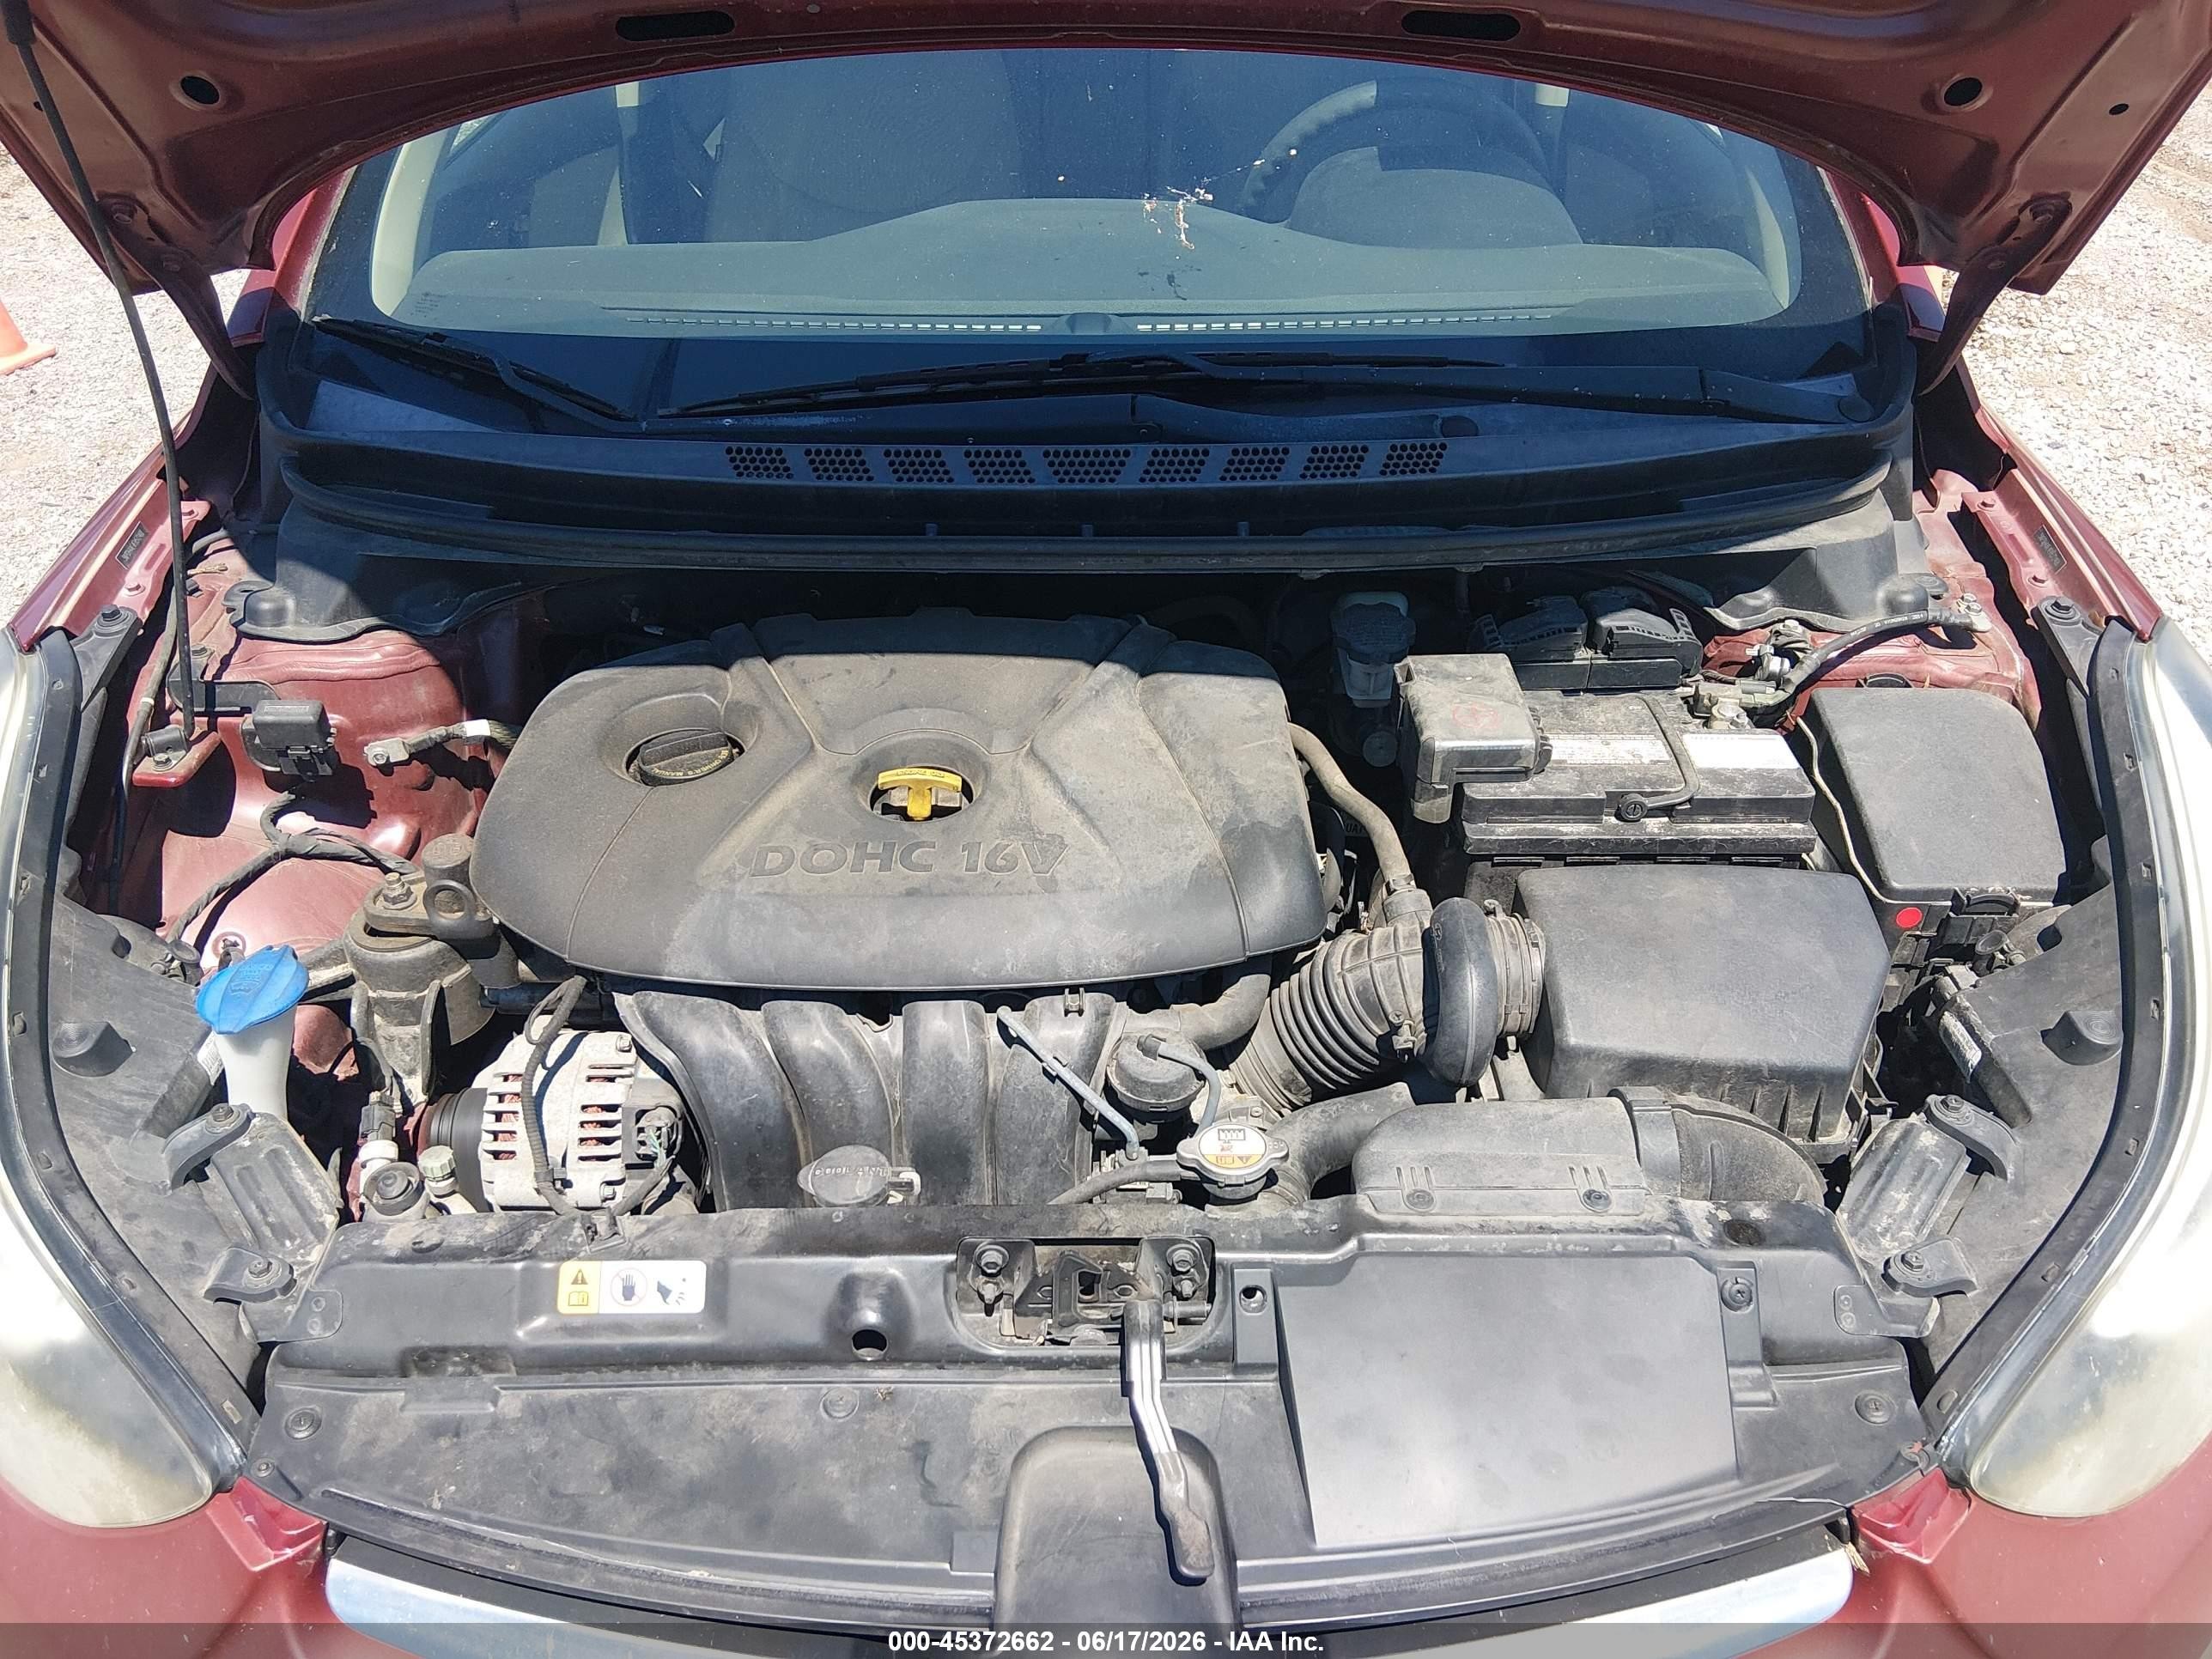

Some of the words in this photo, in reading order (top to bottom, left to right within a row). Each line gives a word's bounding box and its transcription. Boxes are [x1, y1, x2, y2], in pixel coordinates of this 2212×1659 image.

[651, 767, 684, 776] MANUAL
[749, 840, 936, 878] DOHC
[960, 836, 1069, 877] 16V
